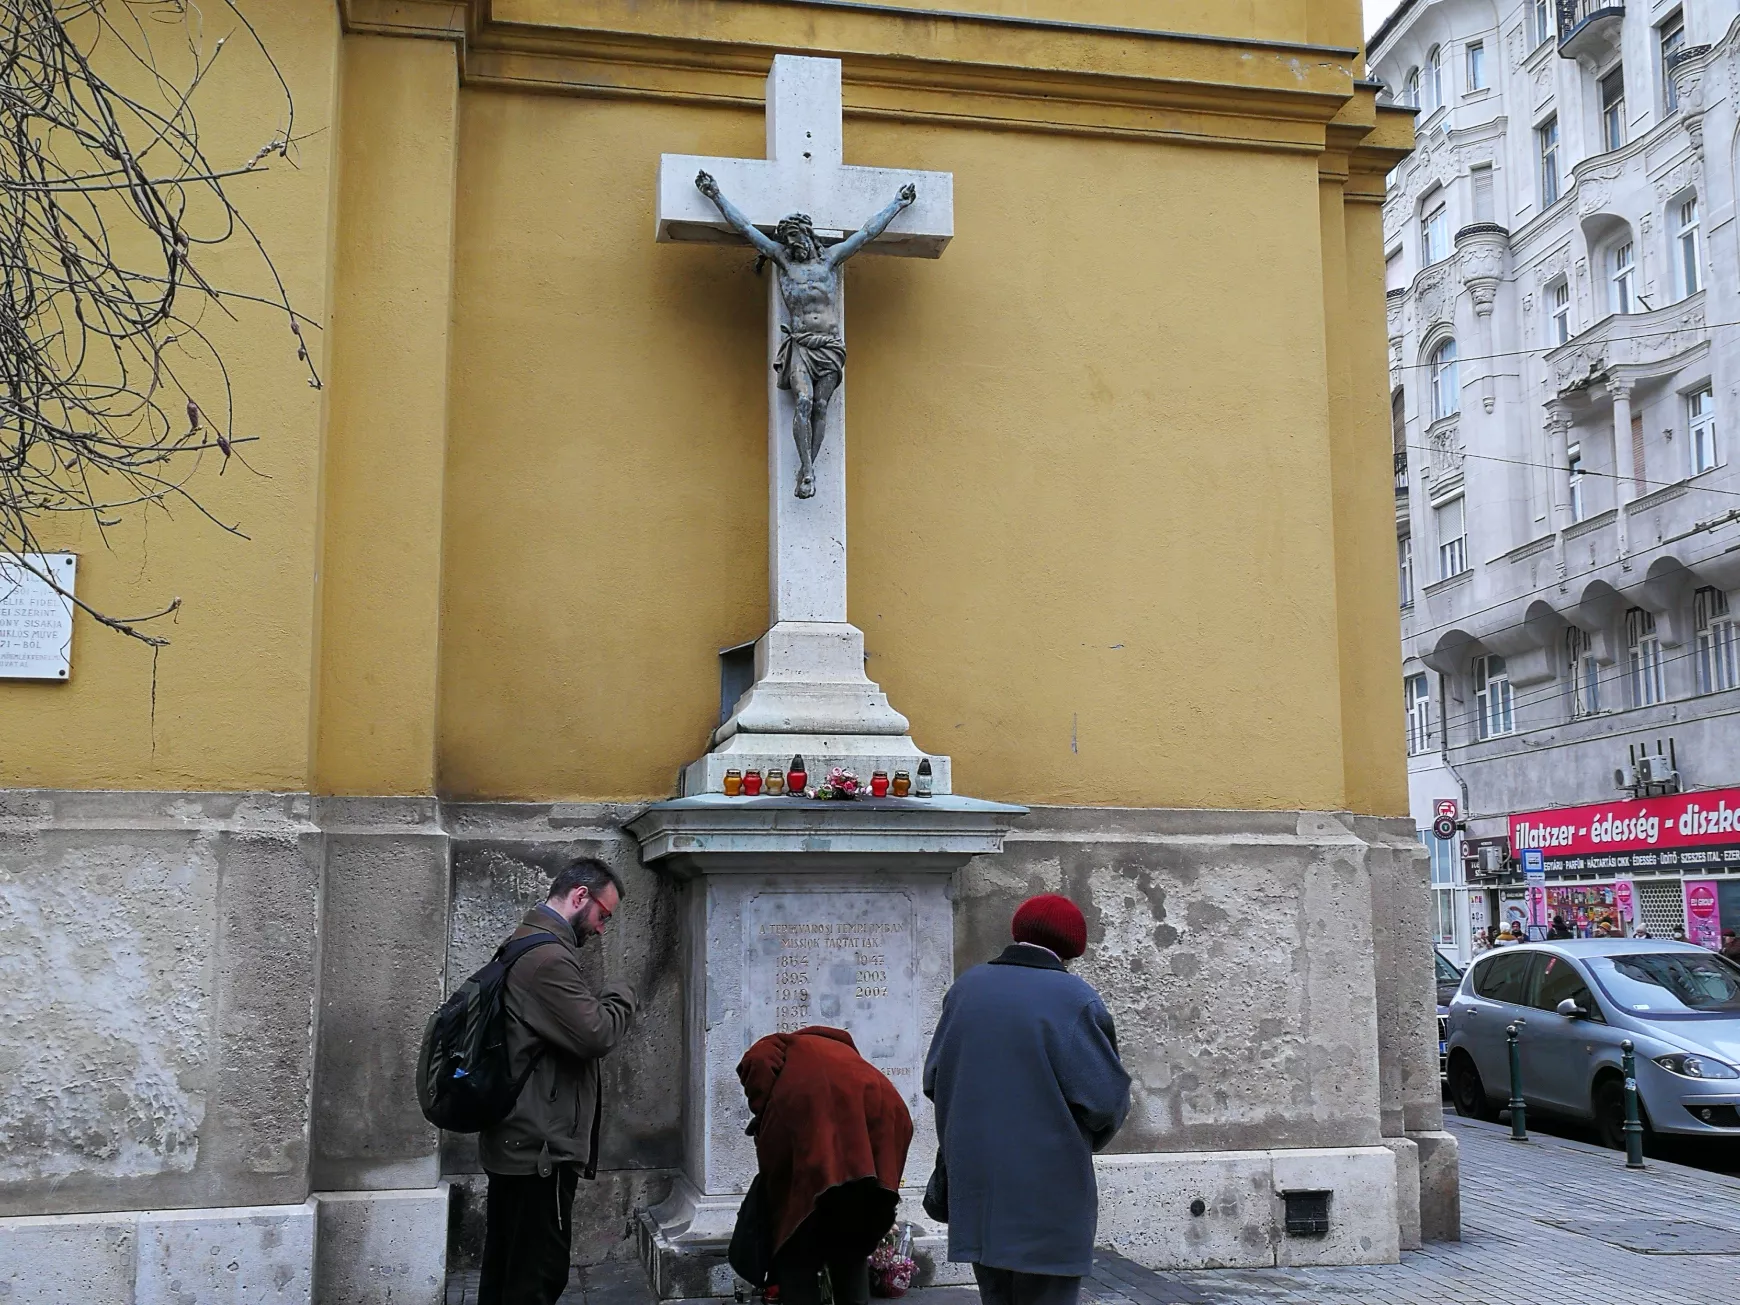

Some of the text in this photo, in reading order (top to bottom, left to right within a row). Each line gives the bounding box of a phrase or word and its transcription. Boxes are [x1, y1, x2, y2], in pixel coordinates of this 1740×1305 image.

[14, 608, 56, 617] SZERINT
[24, 619, 62, 629] SISAKJA
[1515, 822, 1576, 850] illatszer
[1591, 808, 1659, 844] édesség
[1586, 856, 1616, 869] HÁZTARTÁSI
[1632, 853, 1657, 866] ÉDESSÉG
[1680, 852, 1706, 864] SZESZES
[1706, 851, 1721, 862] ITAL
